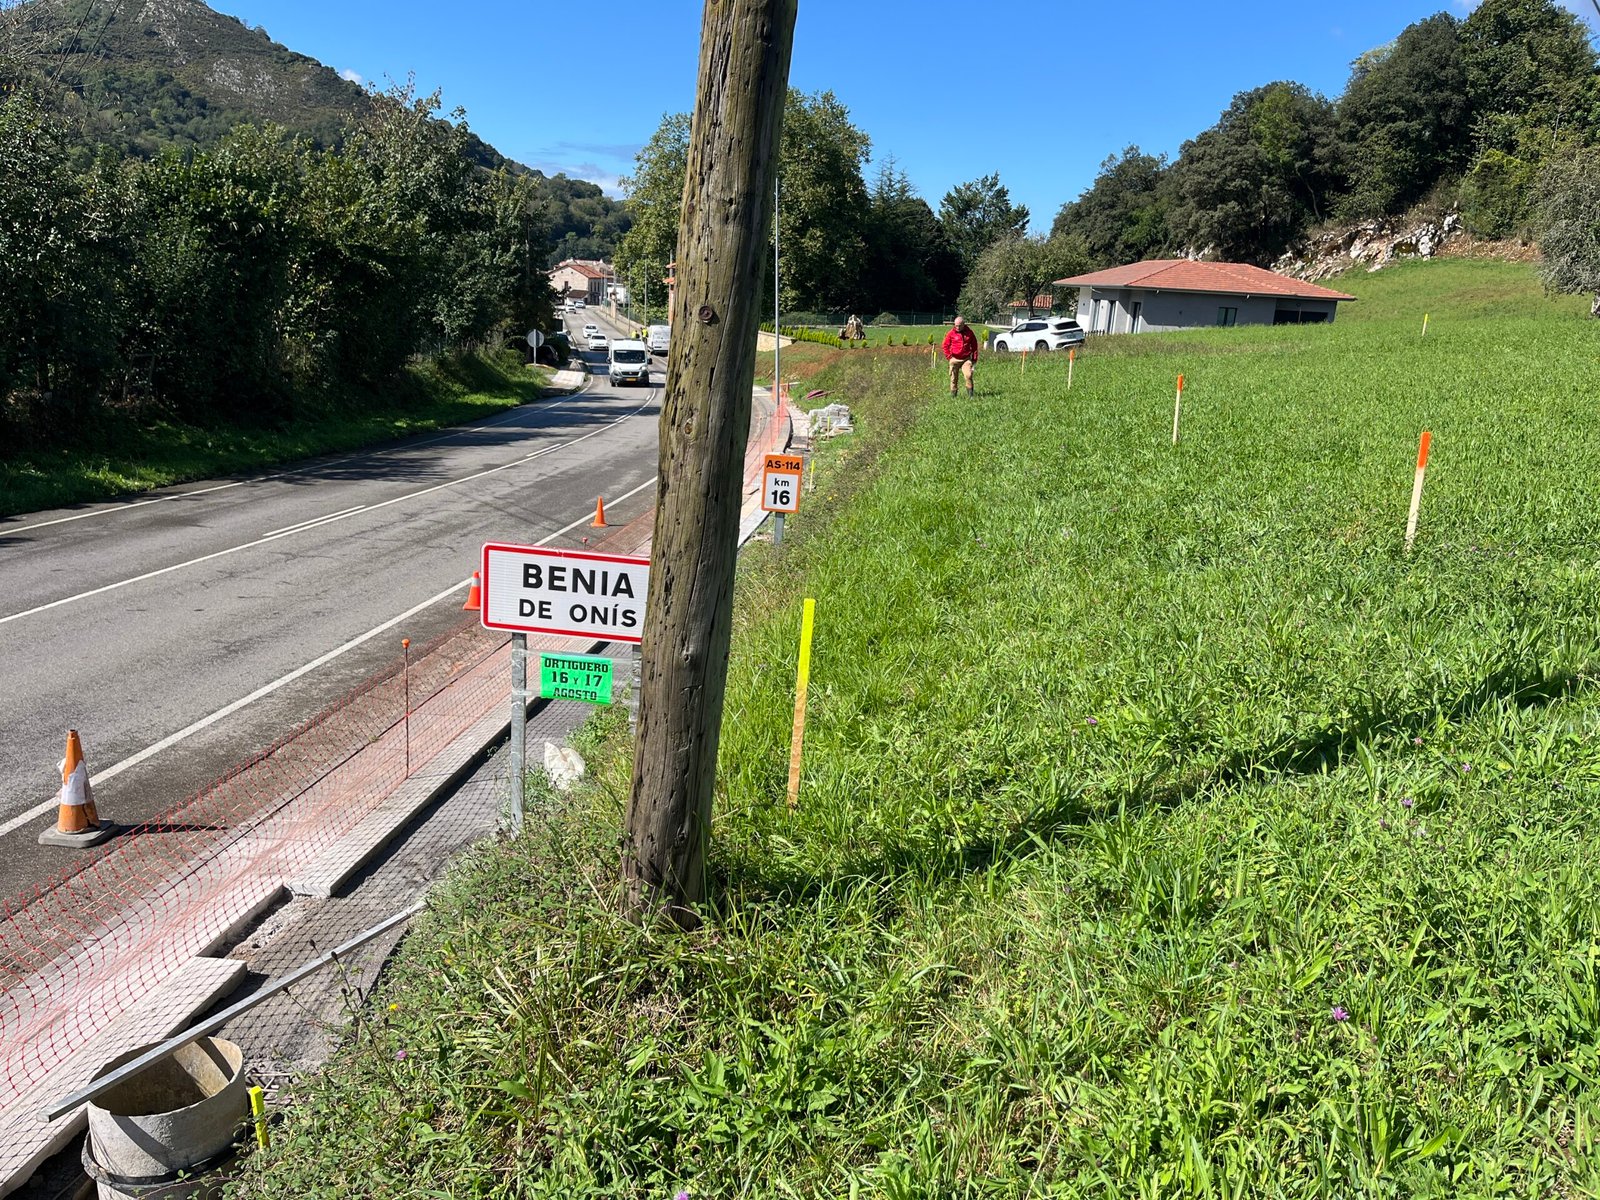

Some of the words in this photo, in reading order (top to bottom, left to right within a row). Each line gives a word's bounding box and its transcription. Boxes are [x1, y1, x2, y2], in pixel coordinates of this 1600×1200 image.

[766, 460, 800, 470] AS-114
[774, 478, 789, 486] km
[771, 490, 790, 505] 16
[523, 563, 634, 598] BENIA
[519, 598, 552, 620] DE
[569, 604, 637, 628] ONÍS
[545, 657, 609, 673] ORTIGUERO
[551, 671, 569, 684] 16
[585, 674, 603, 687] 17
[553, 687, 598, 701] AGOSTO
